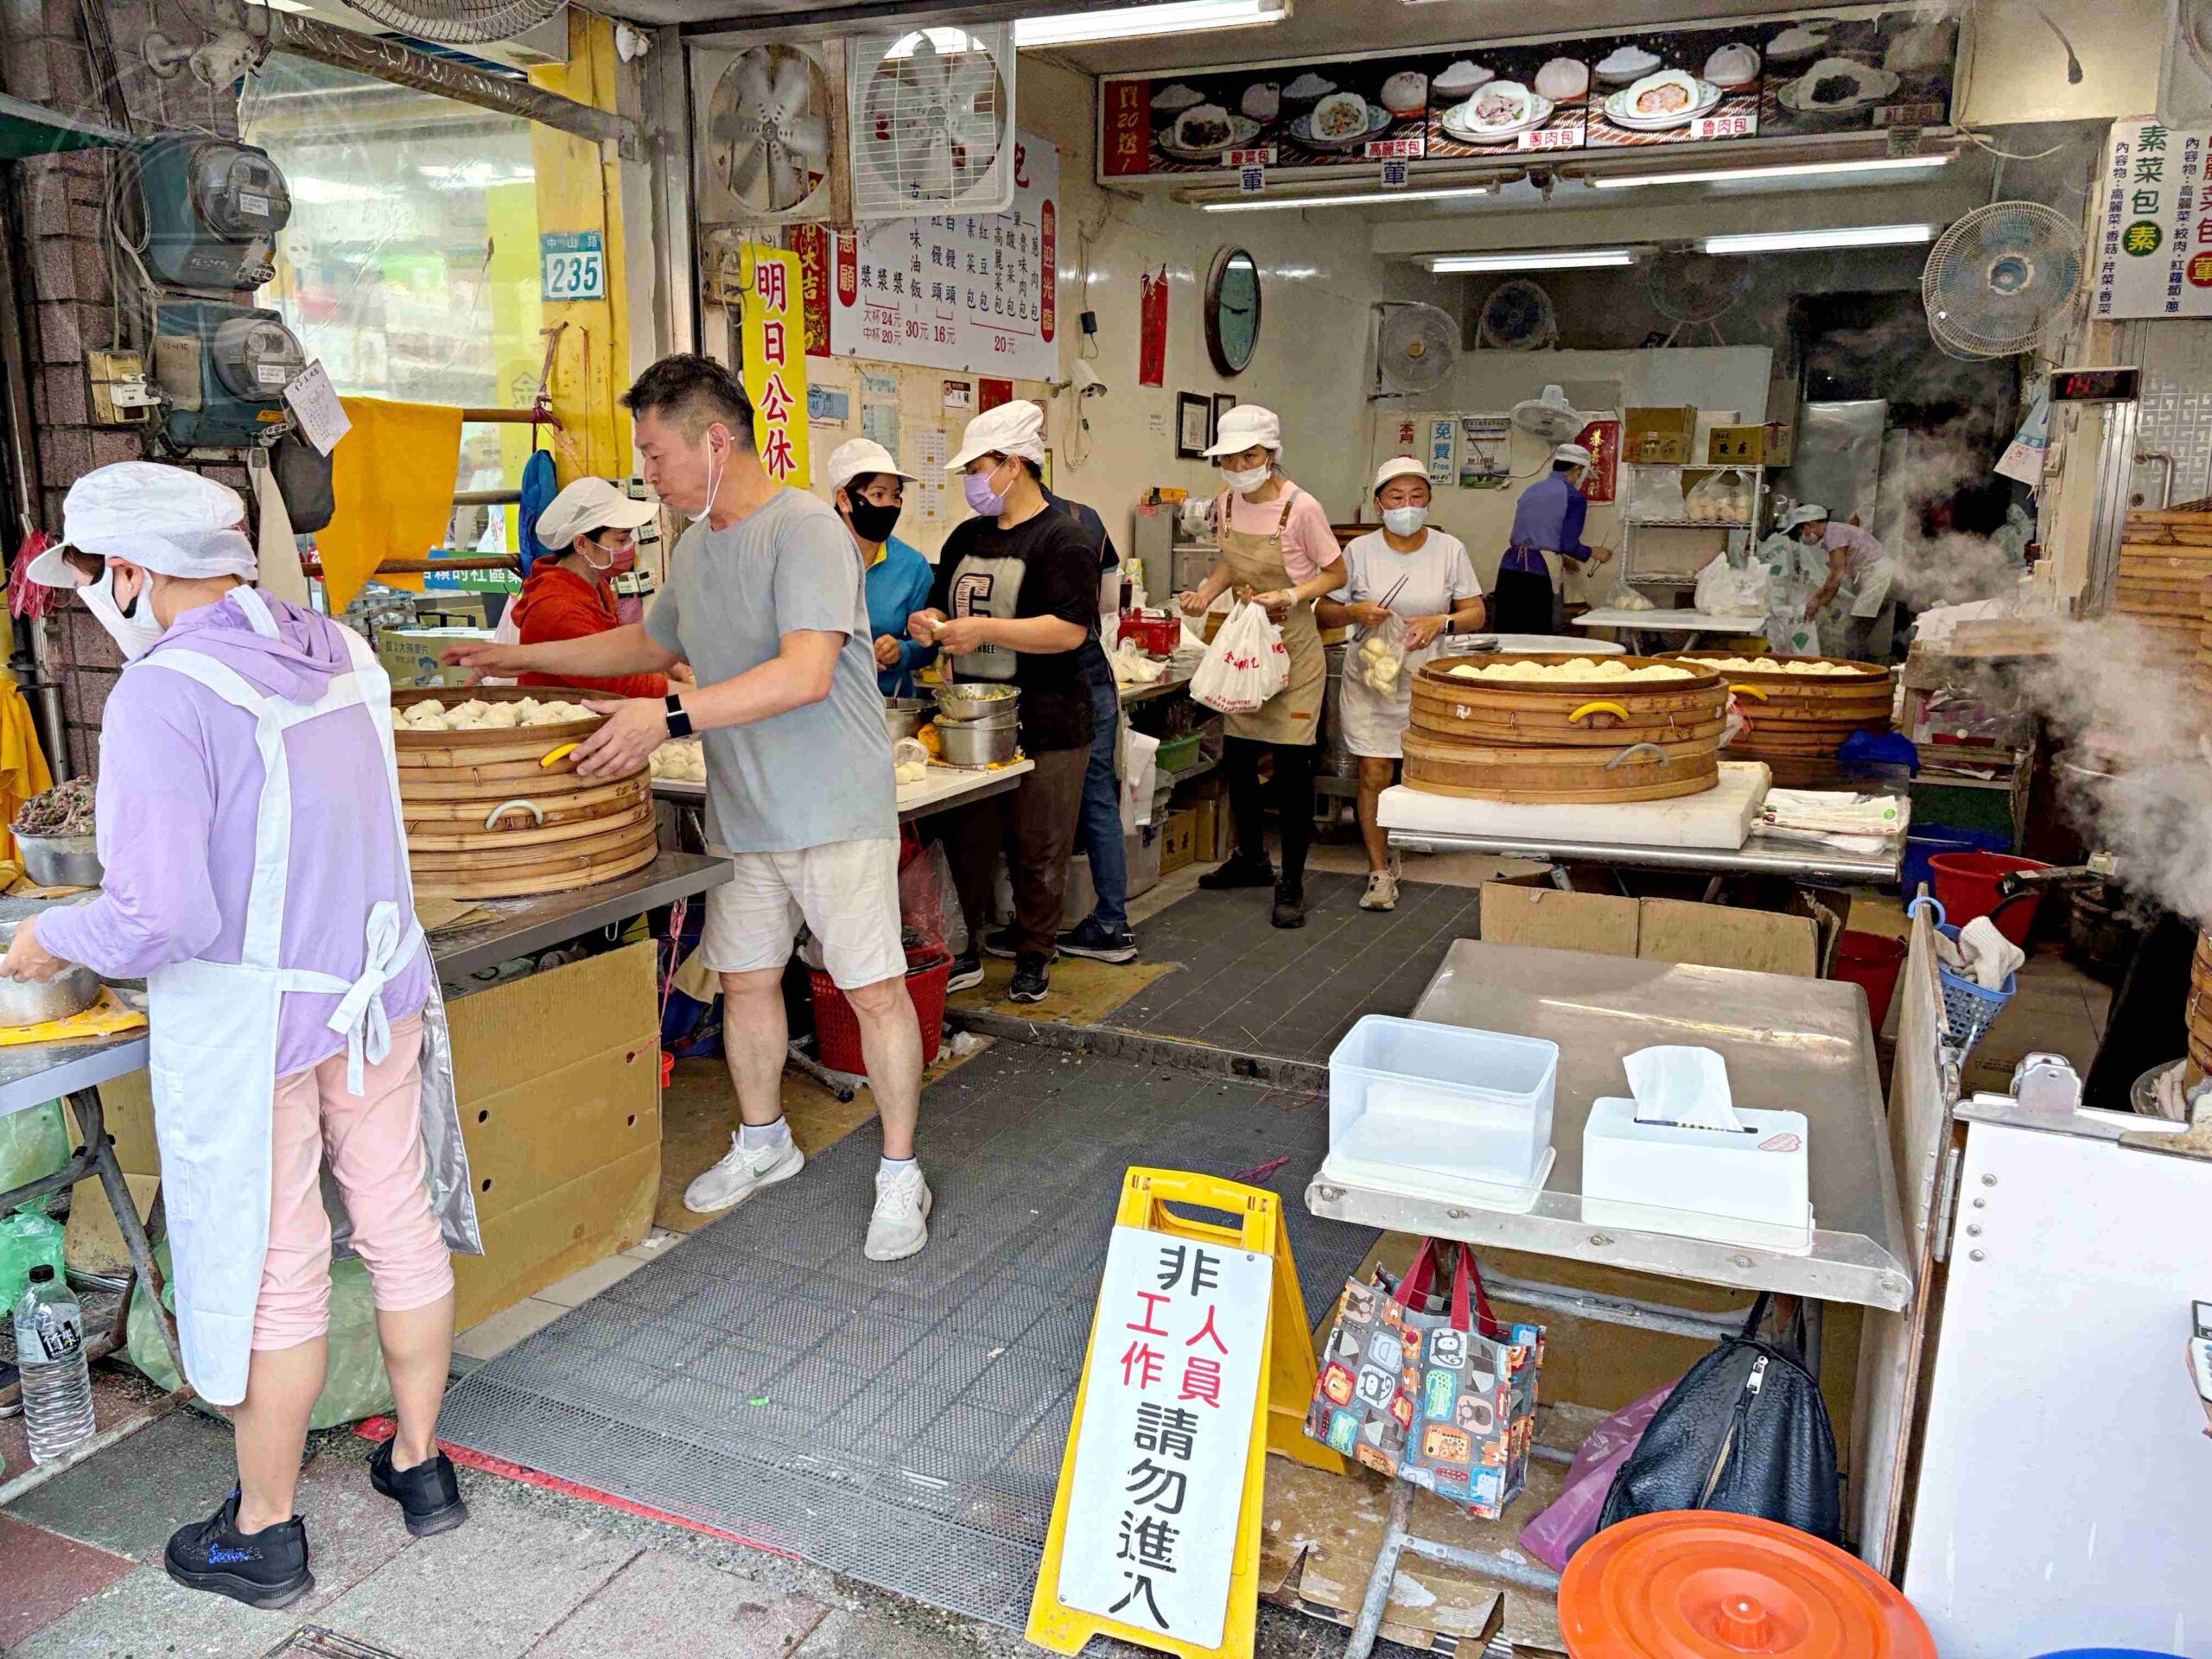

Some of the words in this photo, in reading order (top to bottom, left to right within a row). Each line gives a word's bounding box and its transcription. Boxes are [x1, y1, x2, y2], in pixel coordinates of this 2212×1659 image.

[1702, 118, 1747, 134] 魯肉包
[1230, 149, 1270, 165] 酸菜包
[1368, 141, 1421, 157] 高麗菜包
[1242, 168, 1263, 192] 葷
[1383, 161, 1406, 186] 葷
[2133, 124, 2169, 216] 素菜包
[546, 232, 599, 250] 中山路
[2127, 226, 2157, 252] 素
[551, 256, 599, 293] 235
[965, 218, 976, 309] 素菜包
[979, 222, 990, 313] 紅豆包
[994, 226, 1005, 315] 高麗菜包
[1006, 230, 1017, 318] 酸菜包
[1018, 232, 1029, 321] 魯味肉包
[1043, 213, 1054, 332] 歡迎光臨
[906, 320, 929, 341] 30元
[933, 326, 957, 346] 16元
[994, 335, 1017, 354] 20元
[756, 263, 797, 480] 明日公休
[1434, 422, 1452, 460] 免費
[1429, 473, 1450, 481] Wi-Fi
[1157, 1245, 1221, 1296] 非
[1120, 1291, 1172, 1390] 工作
[1177, 1304, 1229, 1409] 人員
[1108, 1401, 1199, 1630] 請勿進入
